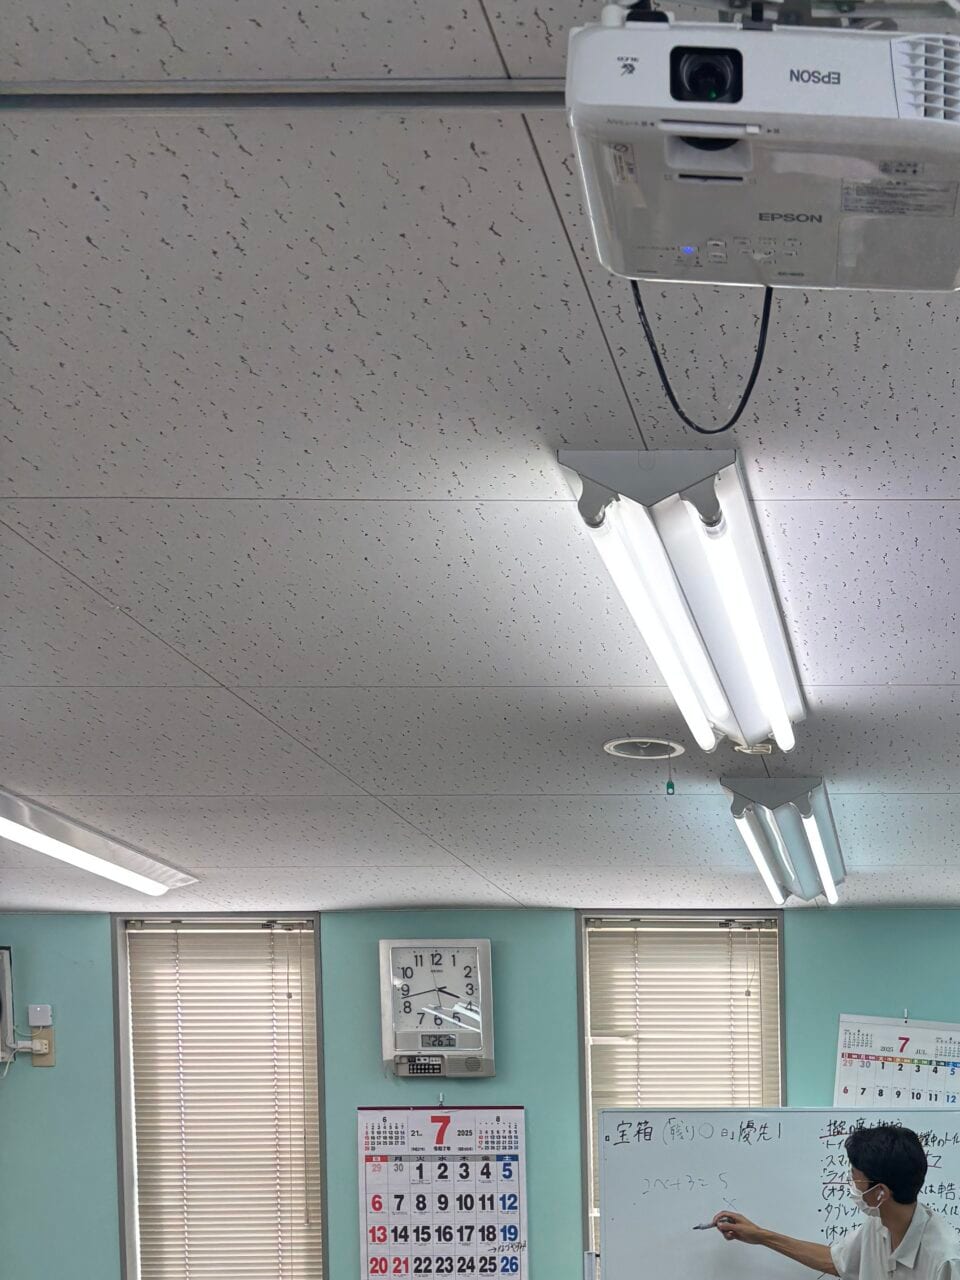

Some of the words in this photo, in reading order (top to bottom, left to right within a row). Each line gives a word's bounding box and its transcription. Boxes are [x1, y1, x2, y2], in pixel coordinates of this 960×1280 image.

[790, 69, 841, 85] EPSON
[758, 212, 823, 223] EPSON
[414, 954, 423, 967] 11
[430, 953, 442, 966] 12
[451, 954, 456, 967] 1
[401, 966, 414, 979] 10
[464, 965, 472, 978] 2
[401, 983, 410, 996] 9
[465, 983, 474, 996] 3
[403, 1000, 412, 1014] 8
[417, 1012, 425, 1025] 7
[433, 1014, 443, 1026] 6
[898, 1036, 910, 1053] 7
[898, 1063, 903, 1071] 2
[932, 1066, 938, 1074] 4
[843, 1086, 848, 1094] 6
[878, 1089, 883, 1097] 8
[896, 1090, 901, 1098] 9
[911, 1092, 921, 1100] 10
[928, 1093, 938, 1101] 11
[946, 1095, 956, 1103] 12
[431, 1116, 450, 1144] 7
[372, 1164, 381, 1172] 29
[394, 1164, 403, 1172] 30
[416, 1163, 423, 1179] 1
[438, 1163, 448, 1179] 2
[459, 1163, 470, 1179] 3
[480, 1163, 491, 1179] 4
[502, 1163, 512, 1179] 5
[372, 1195, 382, 1211] 6
[394, 1195, 404, 1210] 7
[416, 1195, 426, 1211] 8
[438, 1195, 448, 1210] 9
[456, 1194, 474, 1210] 10
[478, 1194, 494, 1210] 11
[499, 1194, 518, 1210] 12
[369, 1226, 387, 1242] 13
[391, 1226, 409, 1242] 14
[413, 1226, 431, 1242] 15
[435, 1226, 453, 1242] 16
[457, 1225, 474, 1242] 17
[478, 1225, 496, 1241] 18
[501, 1225, 518, 1241] 19
[370, 1257, 388, 1274] 20
[393, 1257, 408, 1274] 21
[414, 1257, 432, 1273] 22
[436, 1257, 453, 1273] 23
[458, 1257, 475, 1273] 24
[479, 1256, 497, 1273] 25
[501, 1256, 518, 1272] 26
